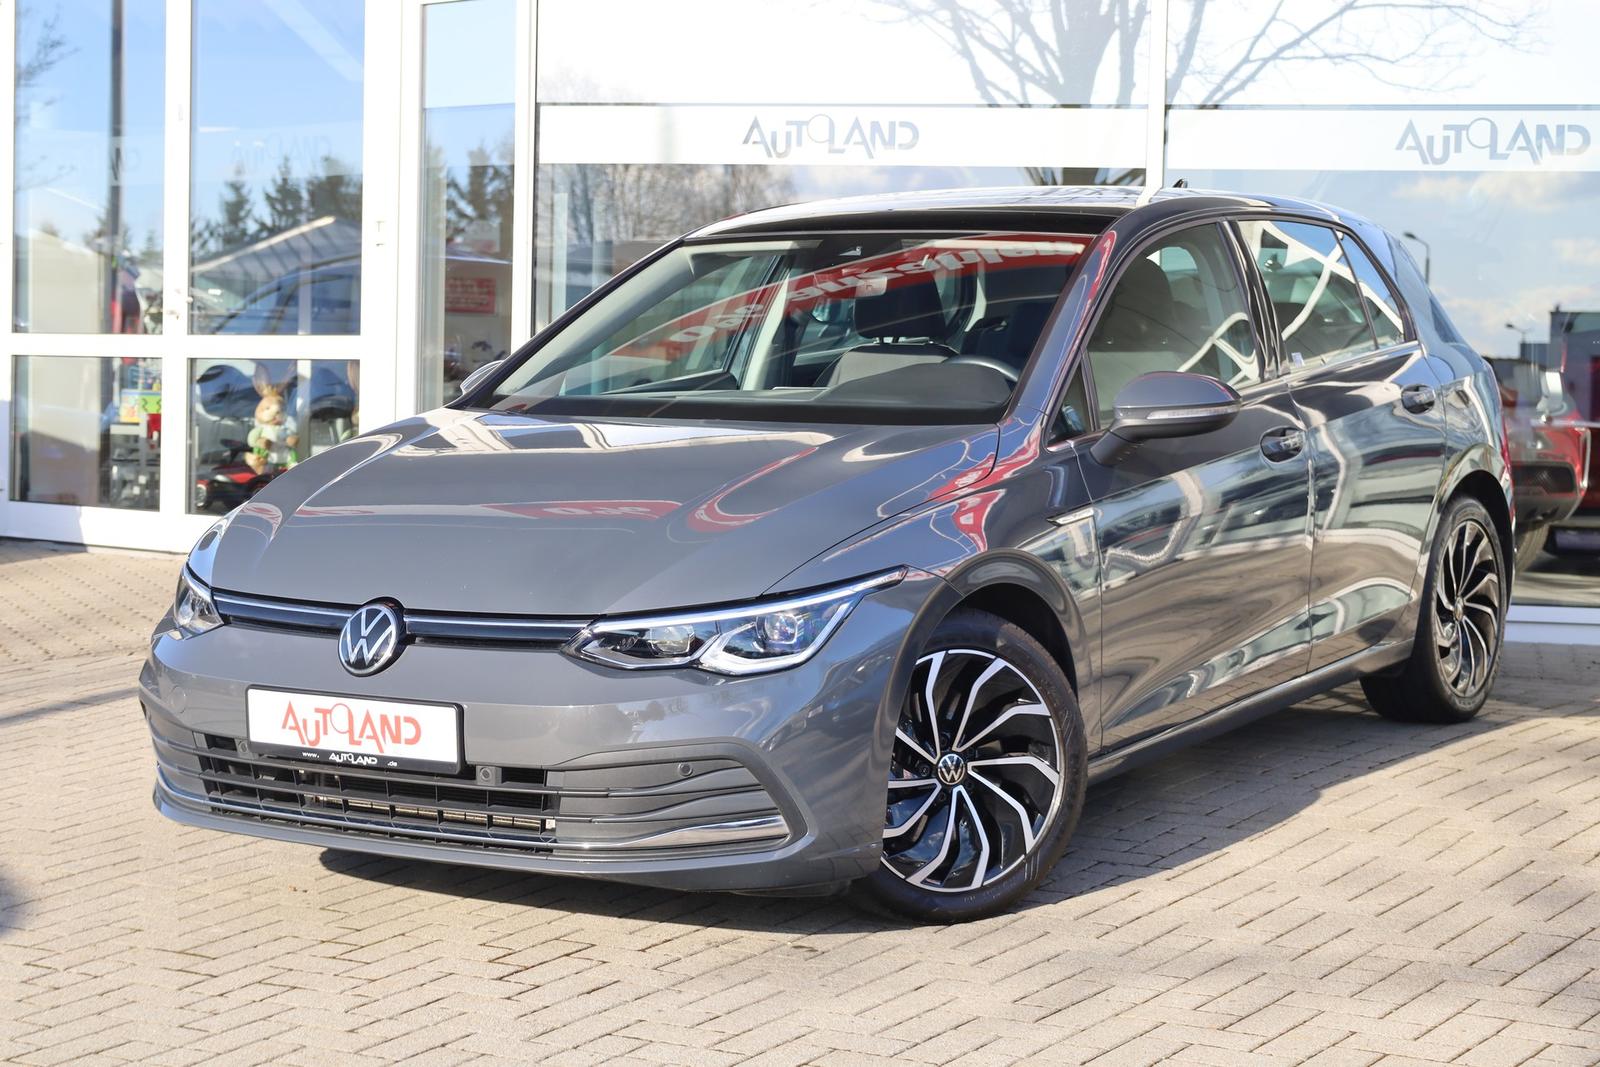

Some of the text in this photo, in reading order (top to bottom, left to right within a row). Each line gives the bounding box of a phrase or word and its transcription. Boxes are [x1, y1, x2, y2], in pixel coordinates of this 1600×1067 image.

[742, 114, 919, 159] AUTOLAND
[1395, 117, 1591, 165] AUTOLAND
[338, 603, 398, 674] VW
[281, 701, 421, 753] AUTOLAND
[329, 752, 377, 765] AUTOLAND
